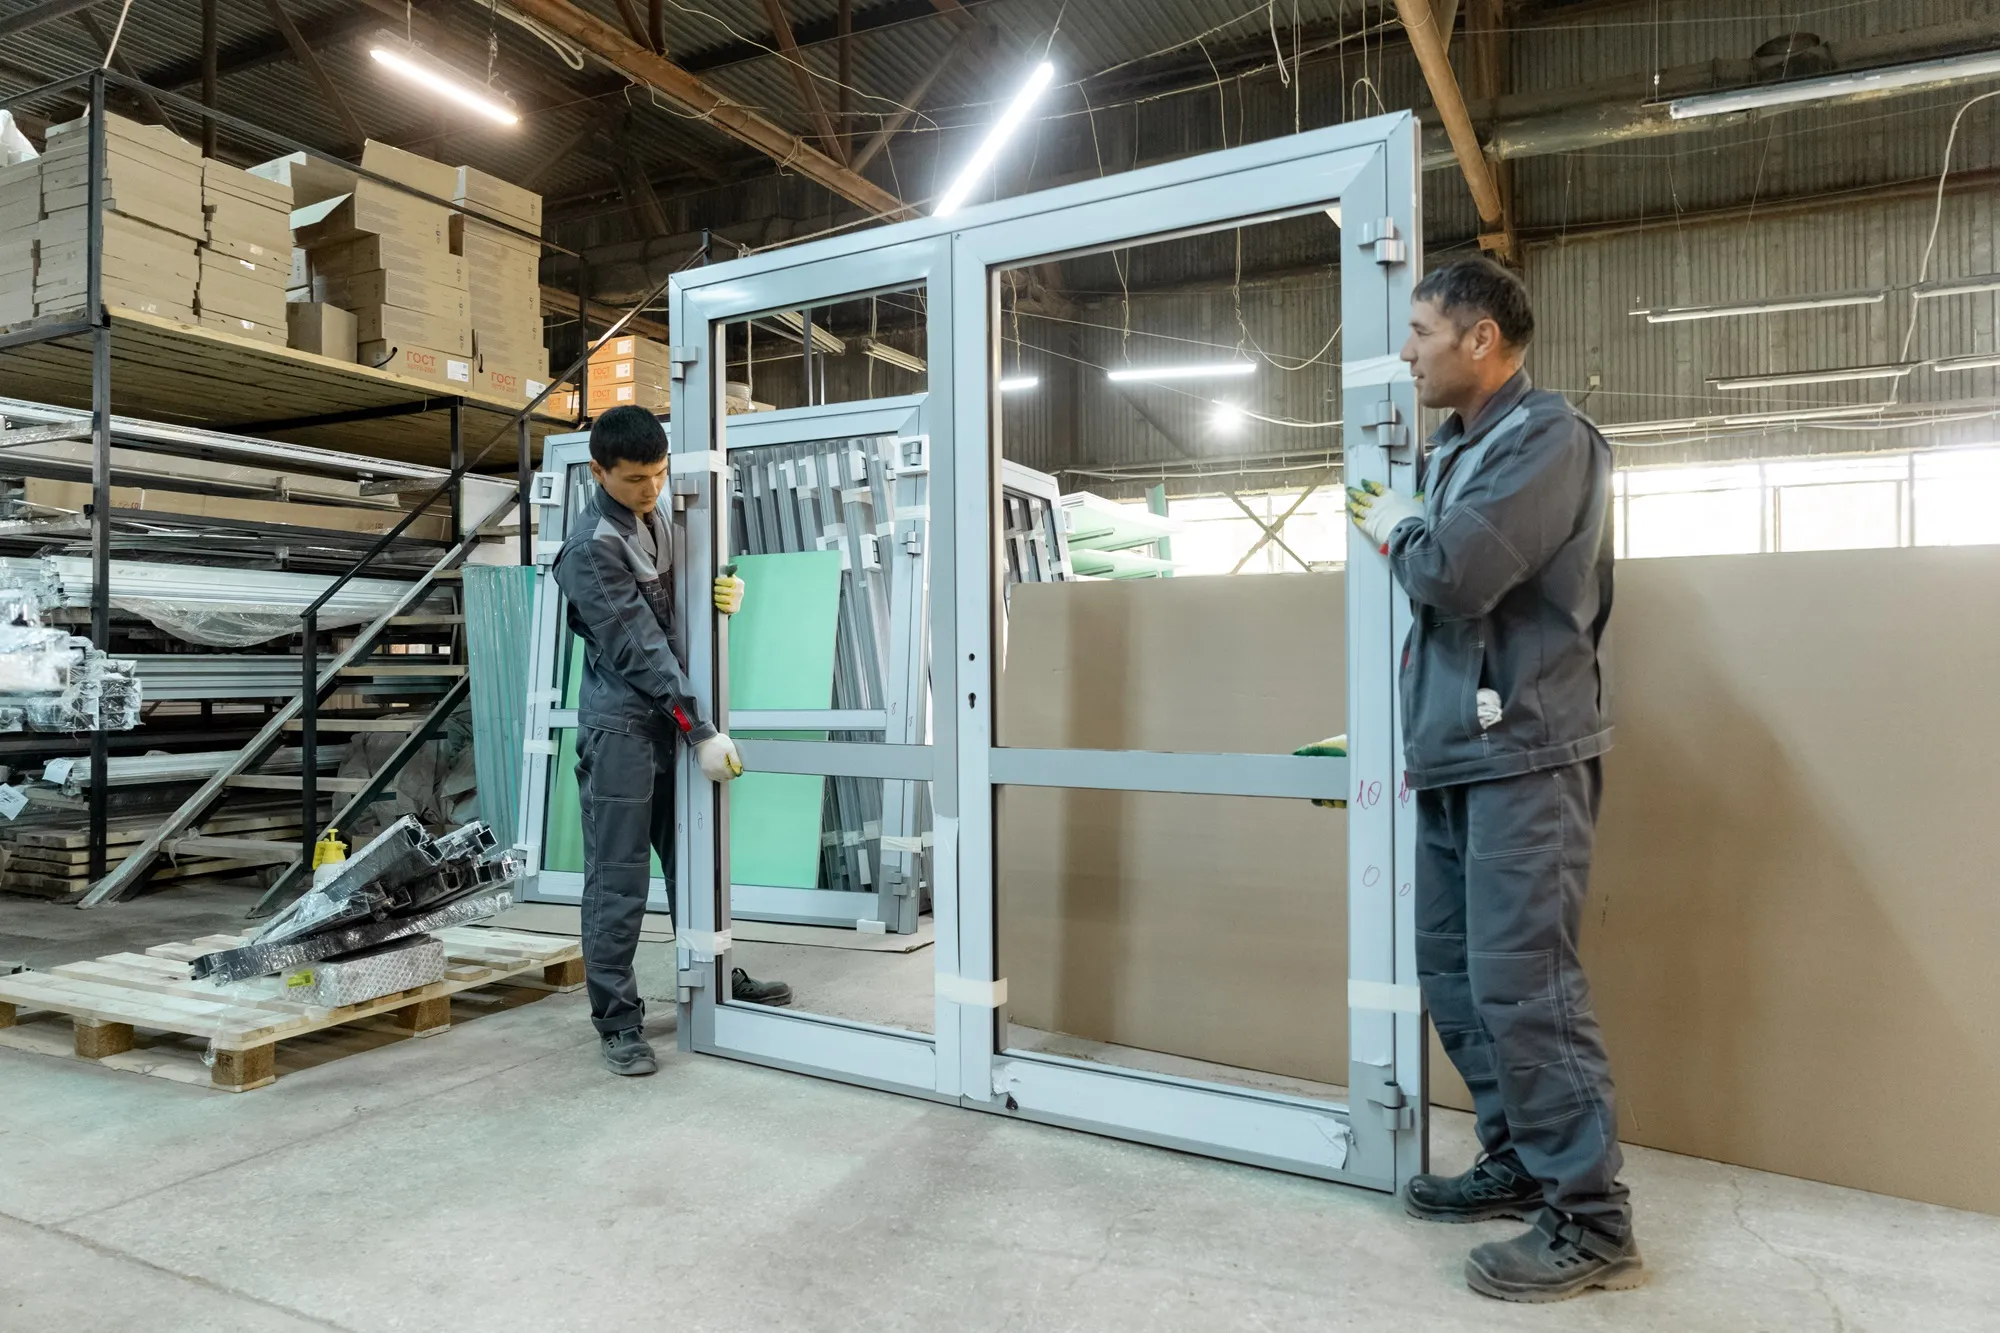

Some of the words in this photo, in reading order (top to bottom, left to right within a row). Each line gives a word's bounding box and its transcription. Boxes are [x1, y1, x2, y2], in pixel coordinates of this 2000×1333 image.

[407, 351, 435, 366] ГОСТ
[491, 372, 517, 386] ГОСТ
[594, 367, 610, 377] ГОСТ
[593, 390, 610, 399] ГОСТ
[1356, 780, 1381, 809] 10
